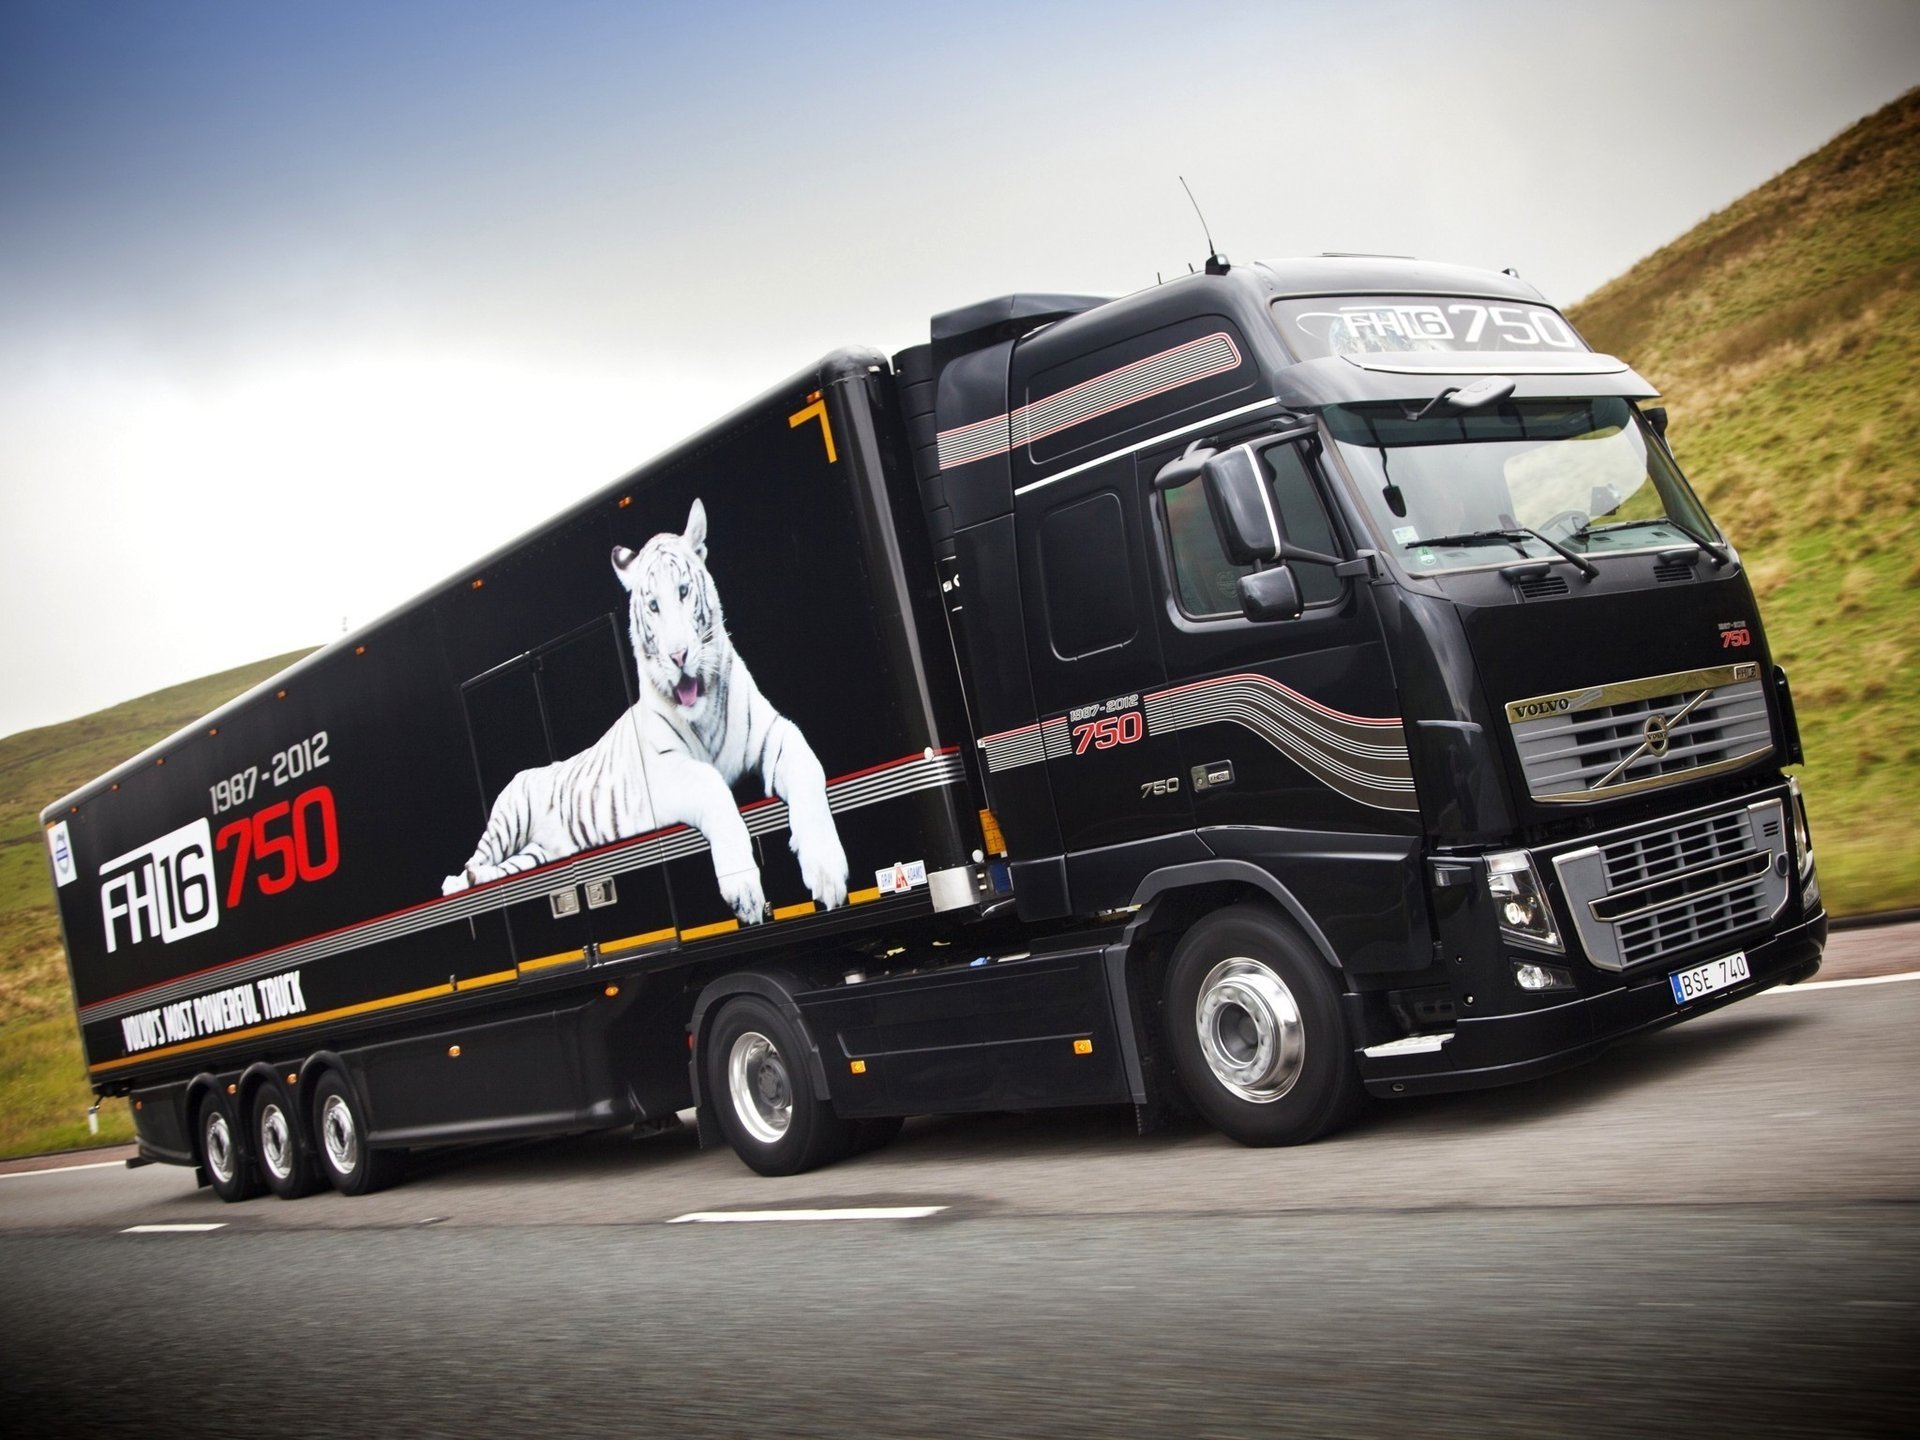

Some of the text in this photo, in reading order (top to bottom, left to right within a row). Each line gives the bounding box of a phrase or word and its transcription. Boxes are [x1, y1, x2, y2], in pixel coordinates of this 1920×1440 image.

[1341, 305, 1576, 348] FH16 750
[1720, 628, 1750, 648] 750
[1513, 698, 1570, 718] VOLVO
[1072, 711, 1143, 755] 750
[209, 731, 330, 815] 1987-2012
[1140, 777, 1180, 799] 750
[216, 785, 340, 908] 750
[100, 828, 216, 953] FH16
[1682, 956, 1746, 996] BSE 740
[162, 999, 196, 1042] MOST
[192, 983, 261, 1036] POWERFUL
[257, 970, 307, 1020] TRUCK
